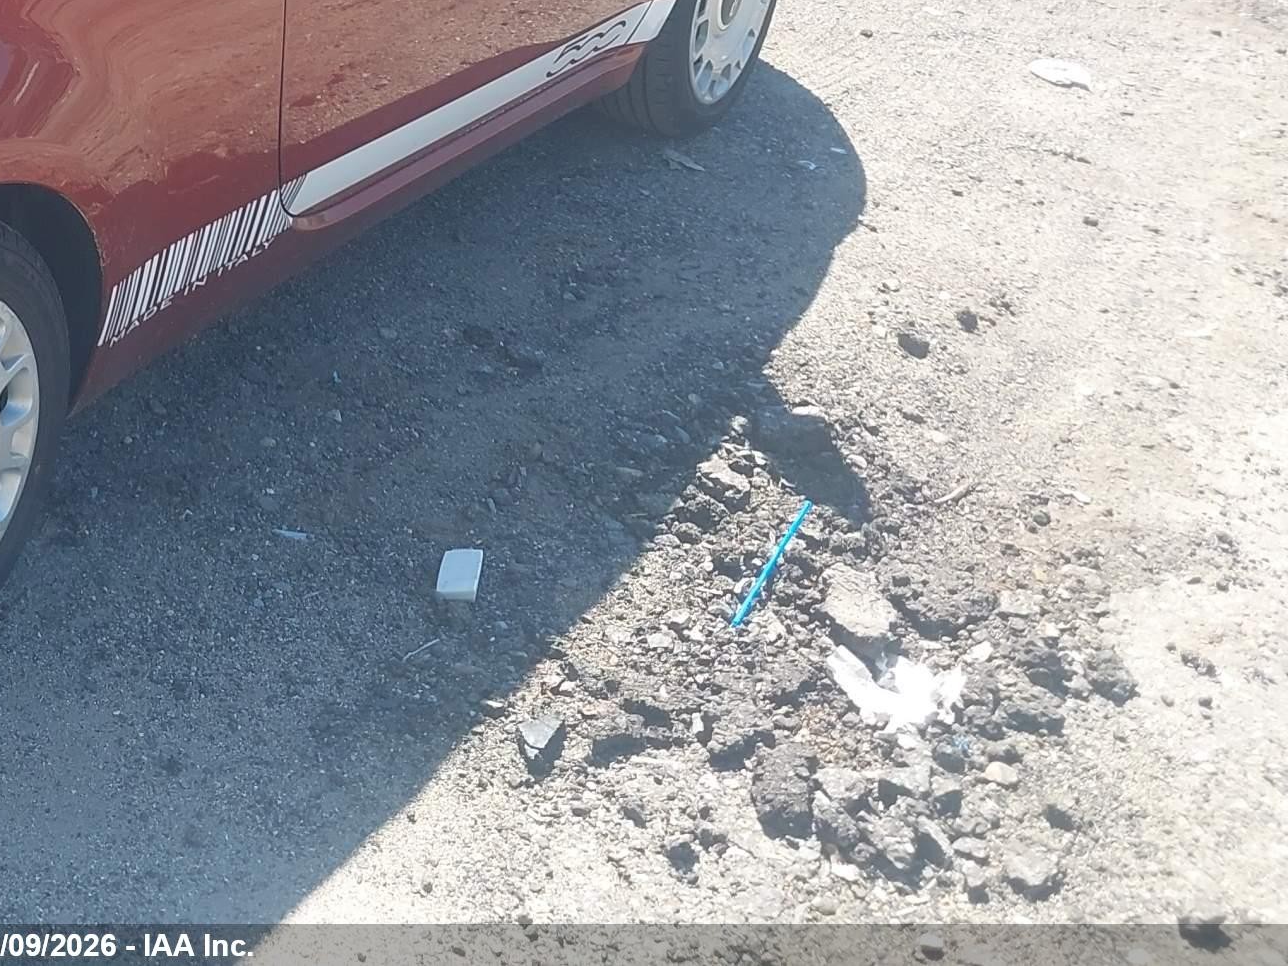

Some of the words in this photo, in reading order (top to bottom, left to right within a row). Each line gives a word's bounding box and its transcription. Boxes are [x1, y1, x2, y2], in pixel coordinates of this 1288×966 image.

[546, 20, 626, 77] 500
[109, 295, 174, 347] MADE
[184, 275, 207, 296] IN
[218, 236, 274, 277] ITALY
